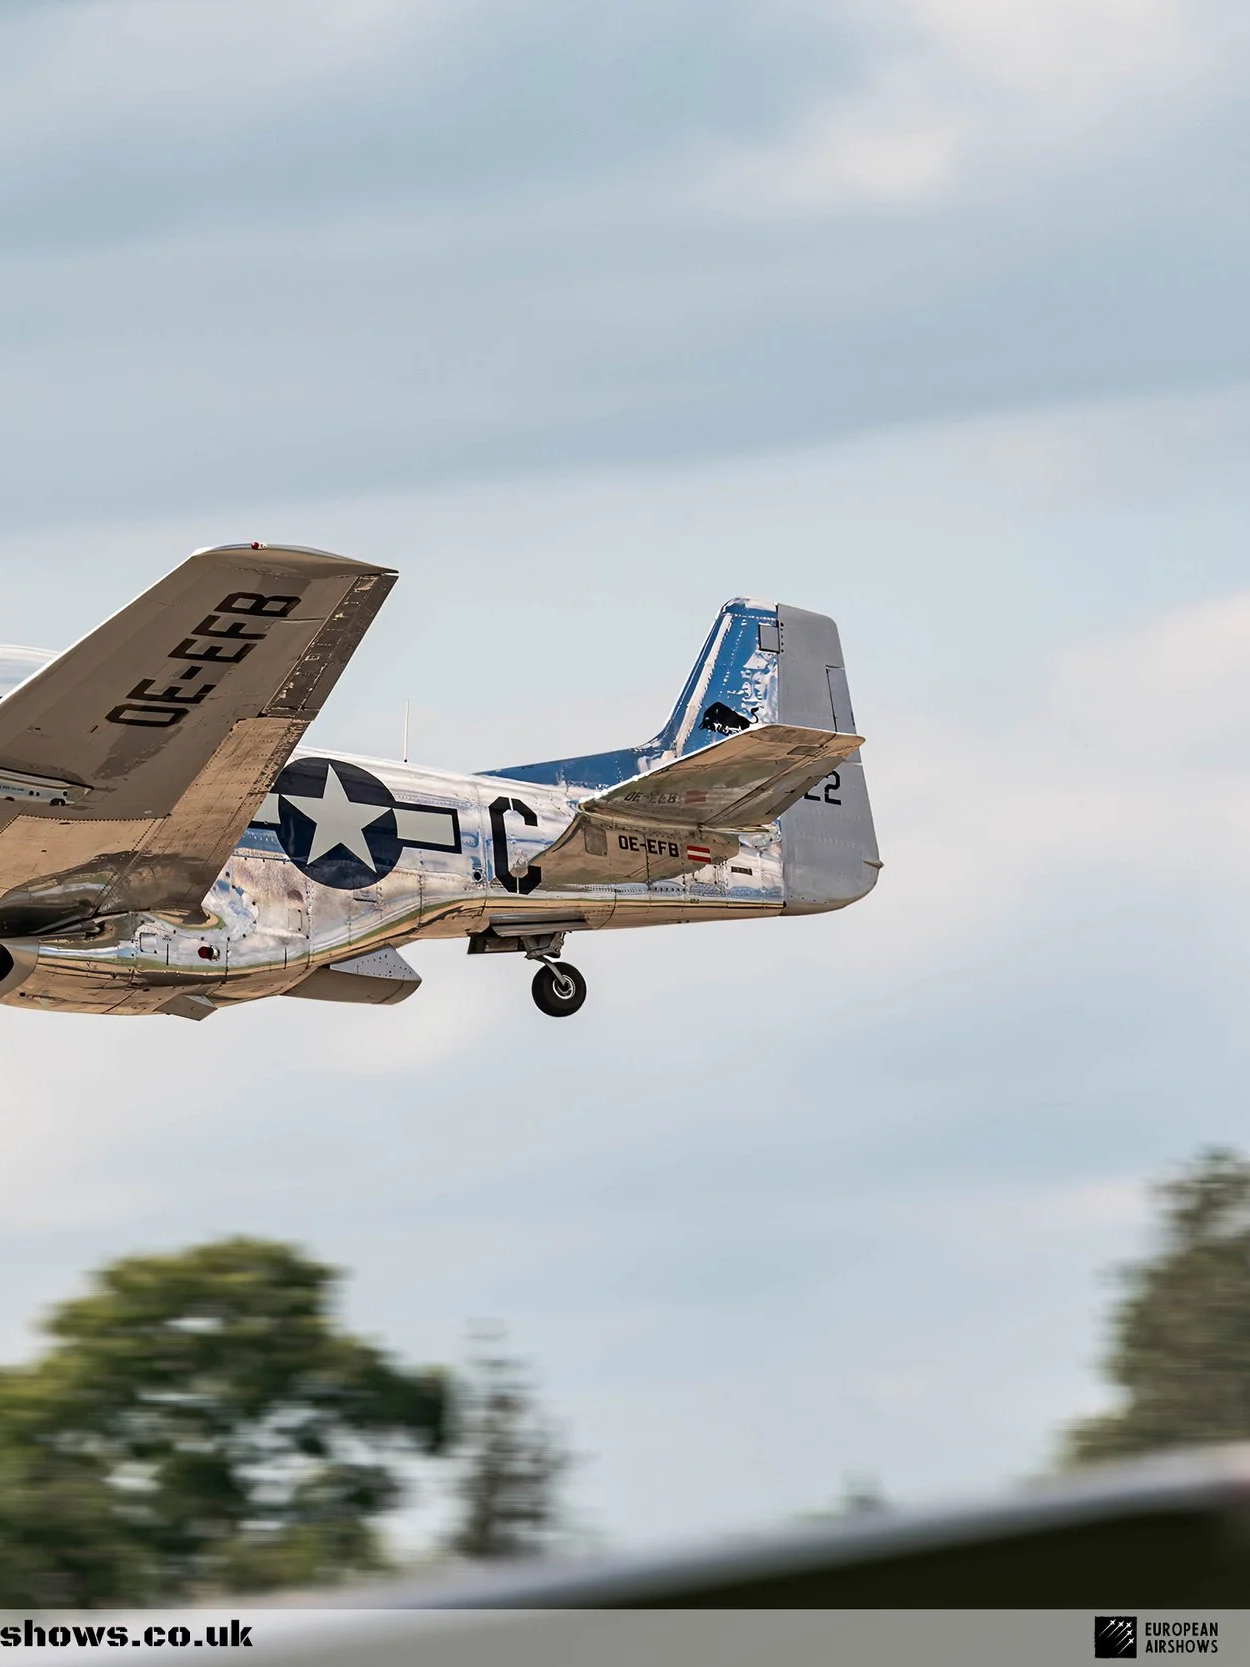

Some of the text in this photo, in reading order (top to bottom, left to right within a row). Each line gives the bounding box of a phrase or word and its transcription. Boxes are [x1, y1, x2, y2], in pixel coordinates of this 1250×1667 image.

[105, 592, 302, 727] OE-EFB
[804, 771, 842, 805] 2
[488, 796, 542, 895] C
[618, 835, 679, 858] OE-EFB
